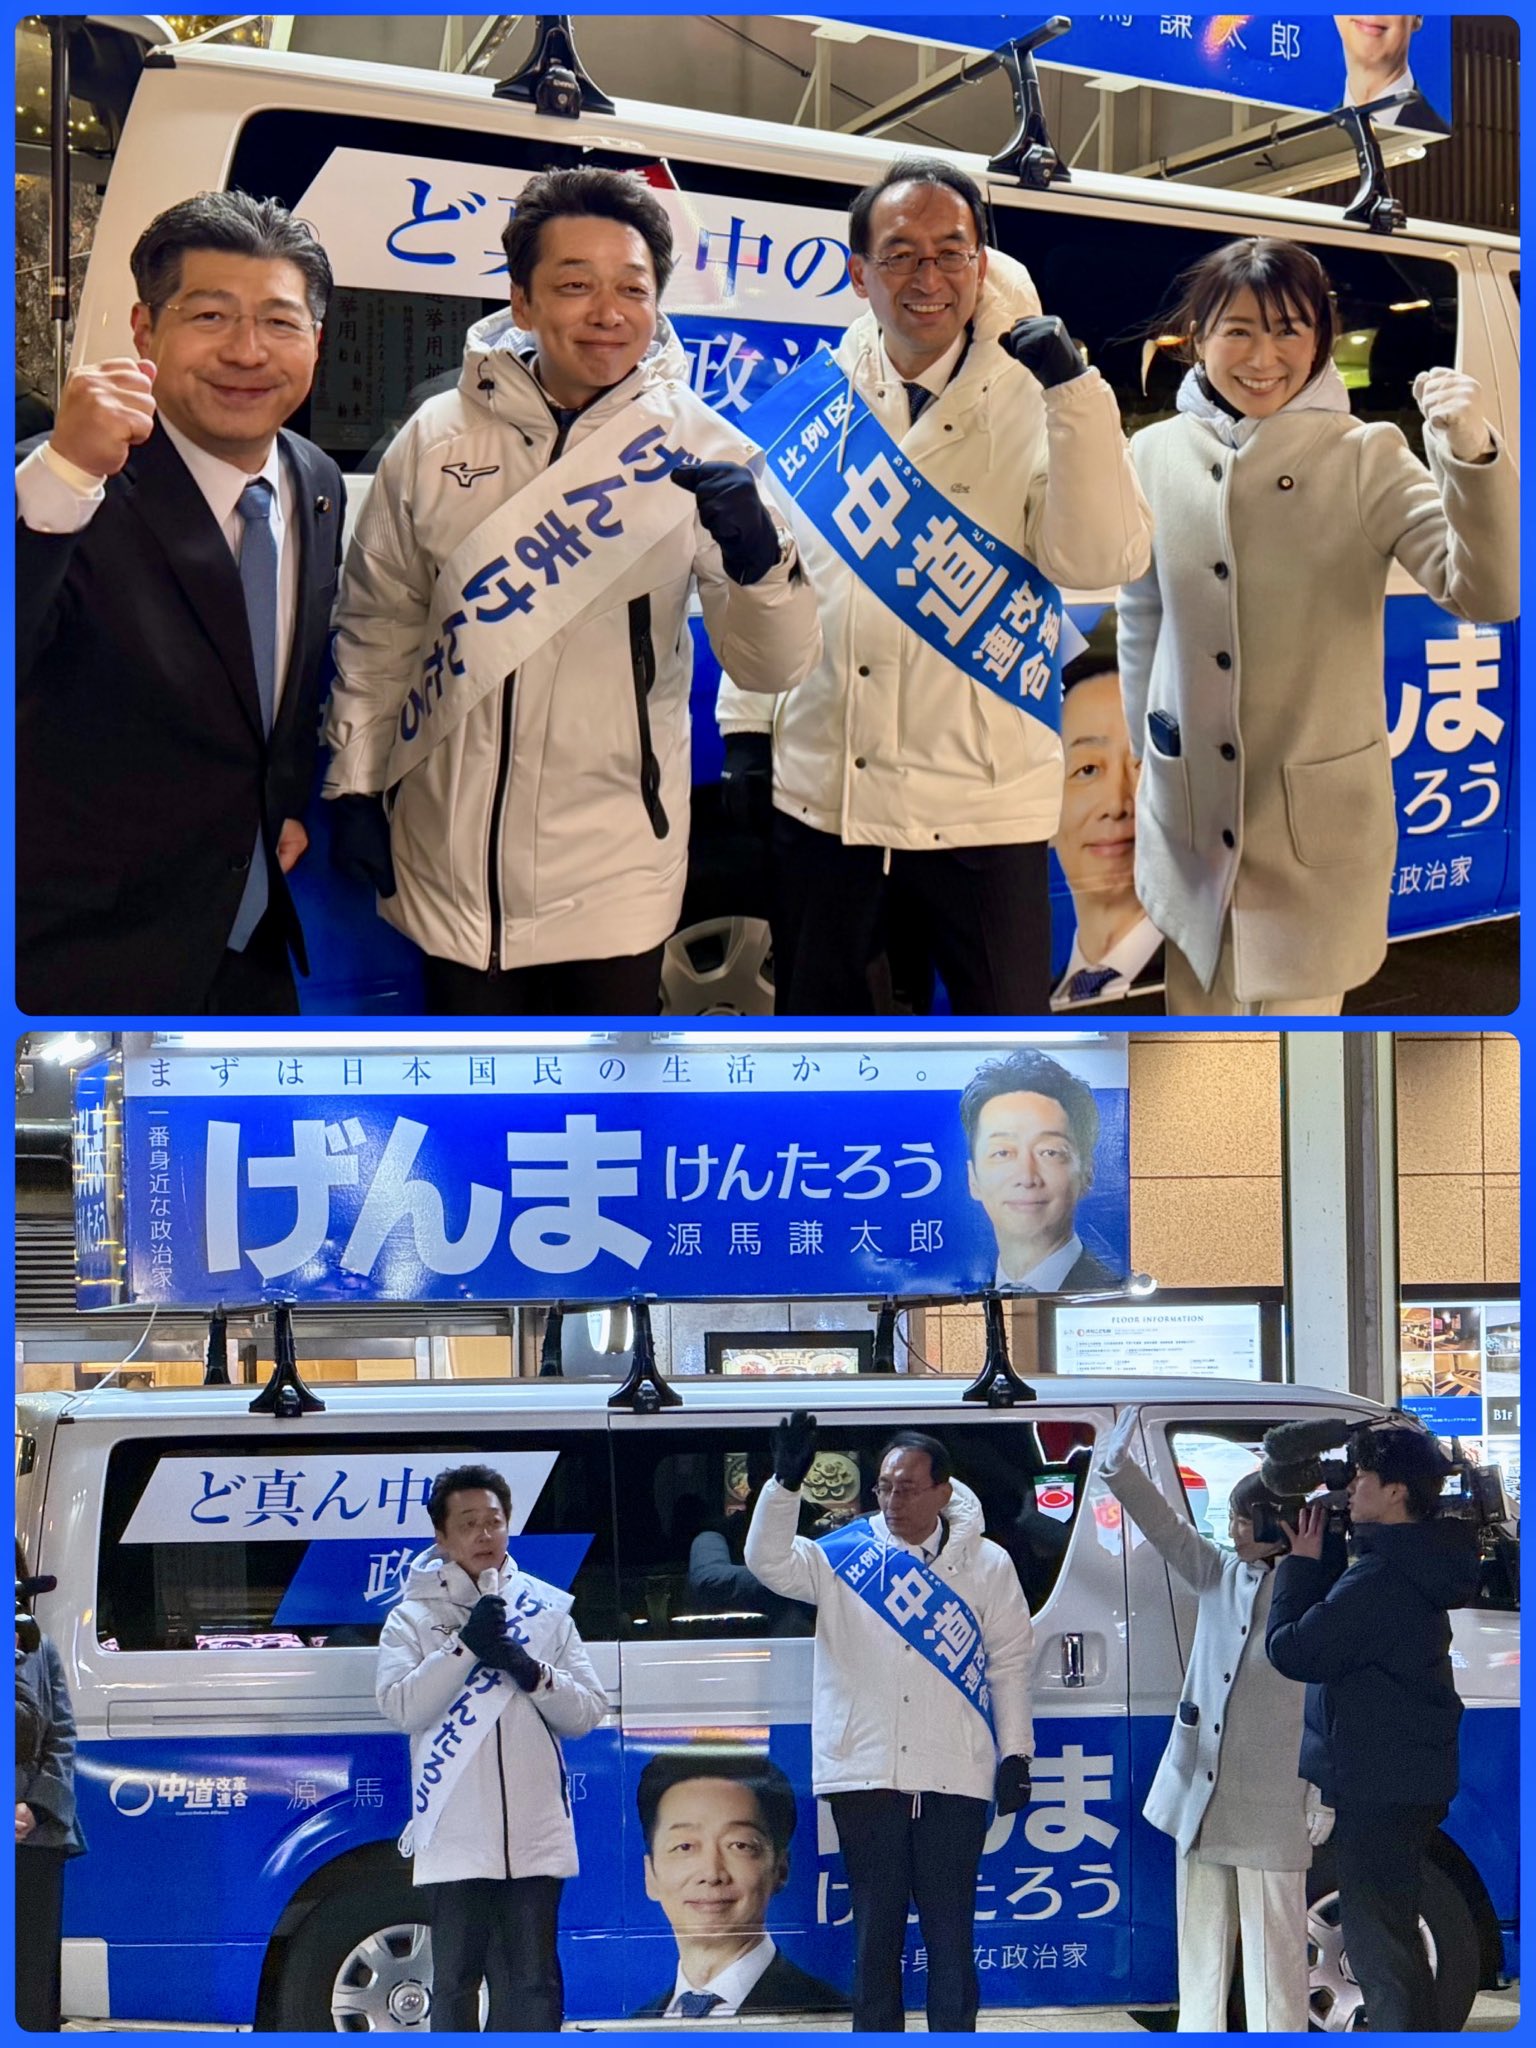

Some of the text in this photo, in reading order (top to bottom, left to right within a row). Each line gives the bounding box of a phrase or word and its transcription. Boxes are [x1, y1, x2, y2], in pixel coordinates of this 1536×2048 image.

[777, 392, 855, 481] 比例区
[149, 1054, 927, 1087] まずは日本国民の生活から。
[148, 1110, 173, 1288] 一番身近な政治家
[206, 1114, 652, 1280] げんま
[665, 1143, 942, 1201] けんたろう
[667, 1219, 944, 1256] 源馬謙太郎
[190, 1467, 433, 1528] ど真ん中
[416, 1590, 552, 1814] げんけんたろう
